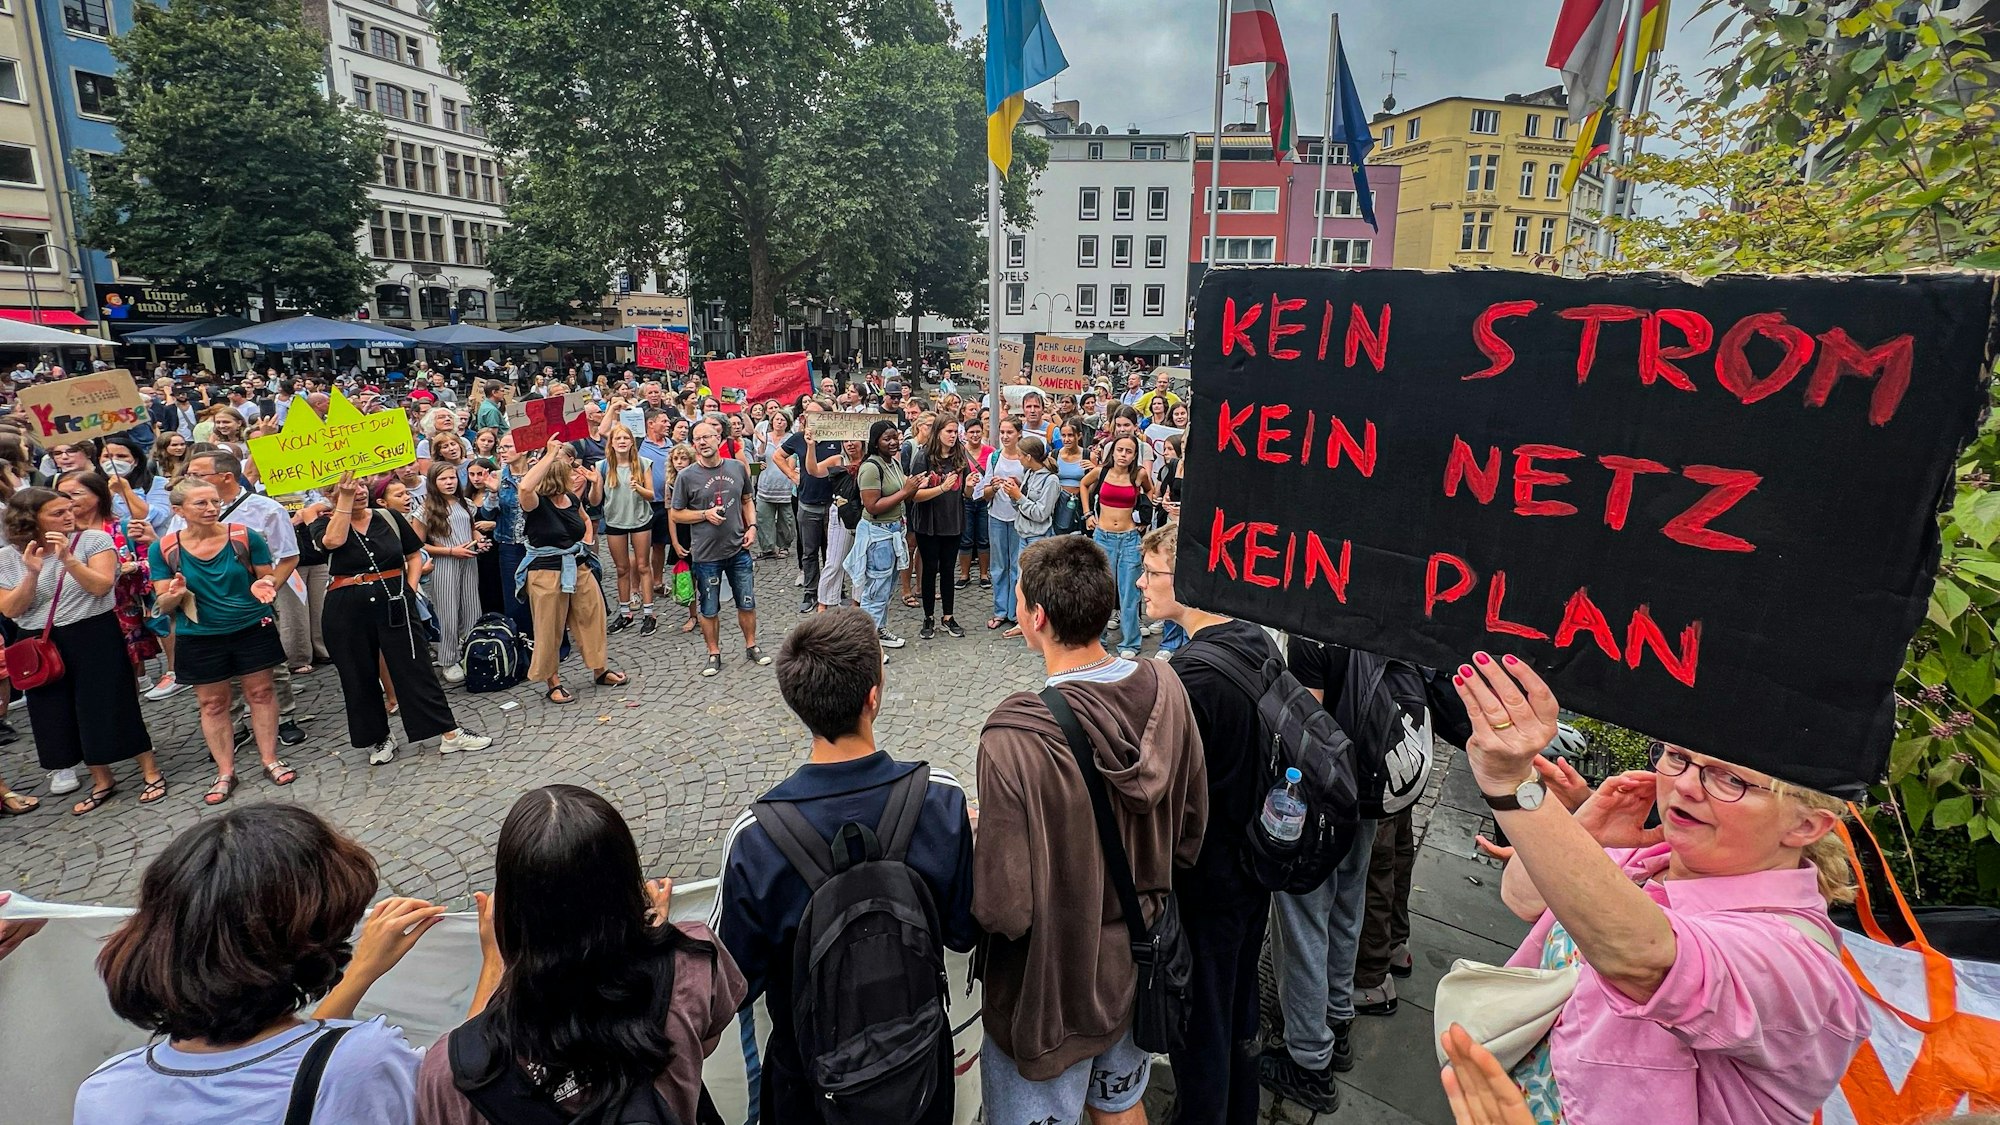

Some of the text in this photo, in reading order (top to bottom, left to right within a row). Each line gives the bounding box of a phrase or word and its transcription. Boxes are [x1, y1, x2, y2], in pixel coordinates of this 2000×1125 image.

[141, 287, 188, 302] Tünne
[137, 301, 167, 313] und
[1075, 318, 1125, 330] DAS CAFÉ
[652, 340, 675, 350] STATT
[1036, 342, 1083, 353] MEHR GELD
[1036, 352, 1048, 362] FÜR
[1221, 292, 1915, 427] KEIN STROM
[1038, 376, 1082, 390] SANIEREN
[816, 413, 851, 421] ZERFALL
[276, 416, 395, 452] KÖLN RETTET DEN
[323, 438, 350, 454] DOM
[269, 464, 309, 484] ABER
[1217, 399, 1764, 554] KEIN NETZ
[1207, 506, 1703, 688] KEIN PLAN
